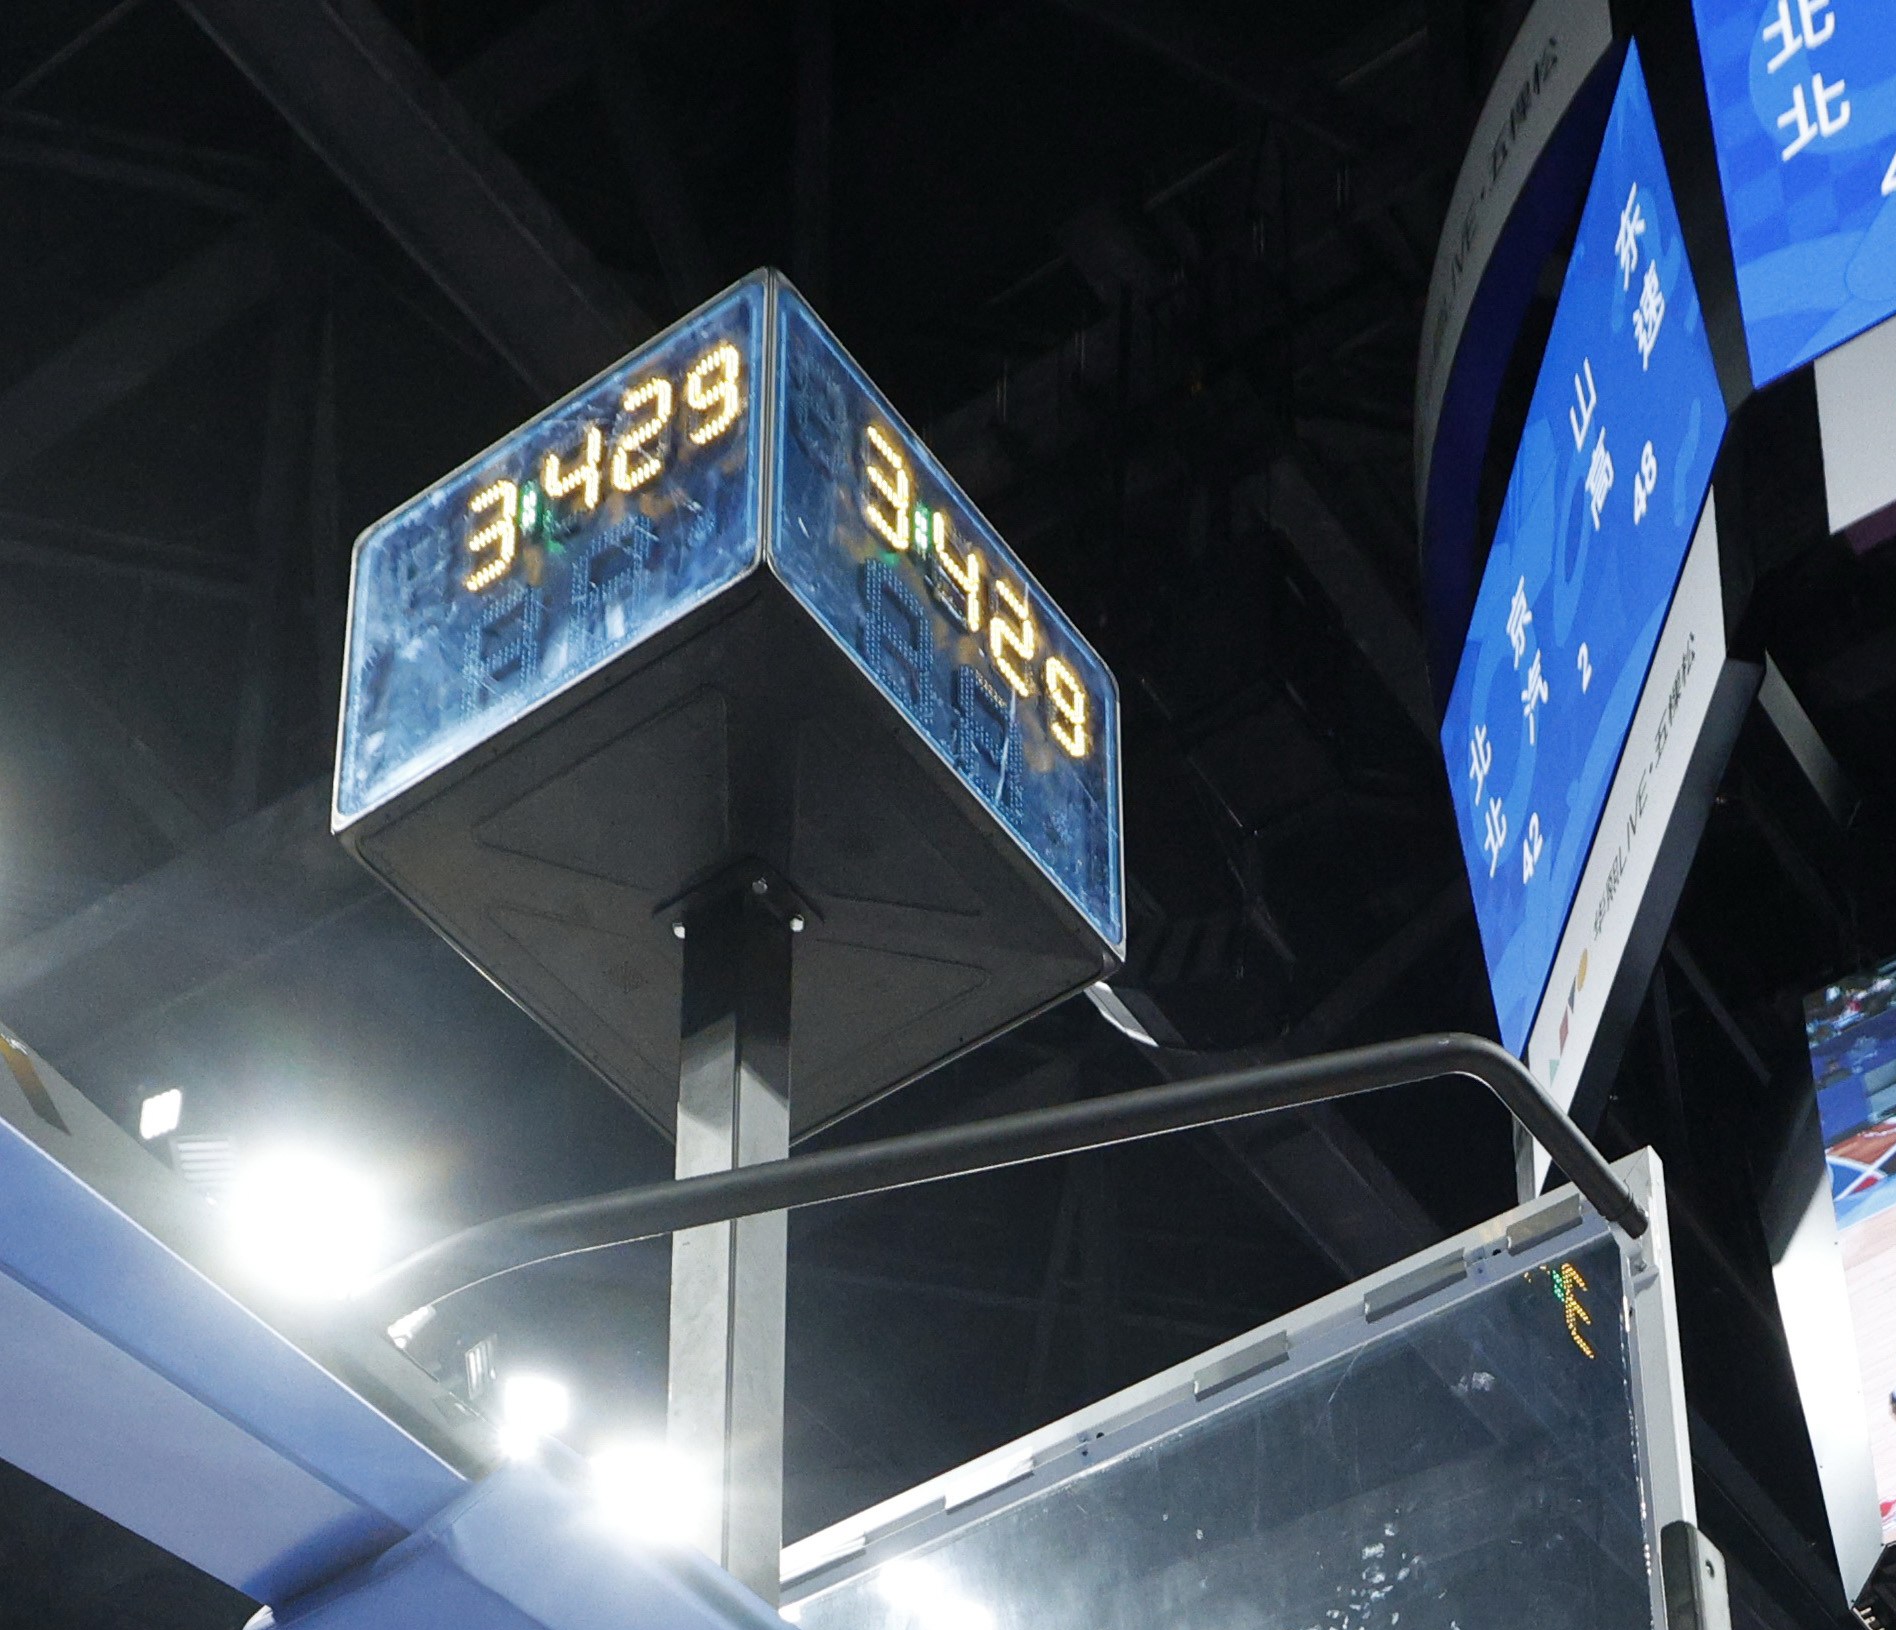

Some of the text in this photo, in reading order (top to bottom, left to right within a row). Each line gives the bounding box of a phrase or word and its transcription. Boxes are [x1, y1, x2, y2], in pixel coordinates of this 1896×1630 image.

[1777, 73, 1851, 162] 北
[1521, 440, 1657, 885] 42 2 48
